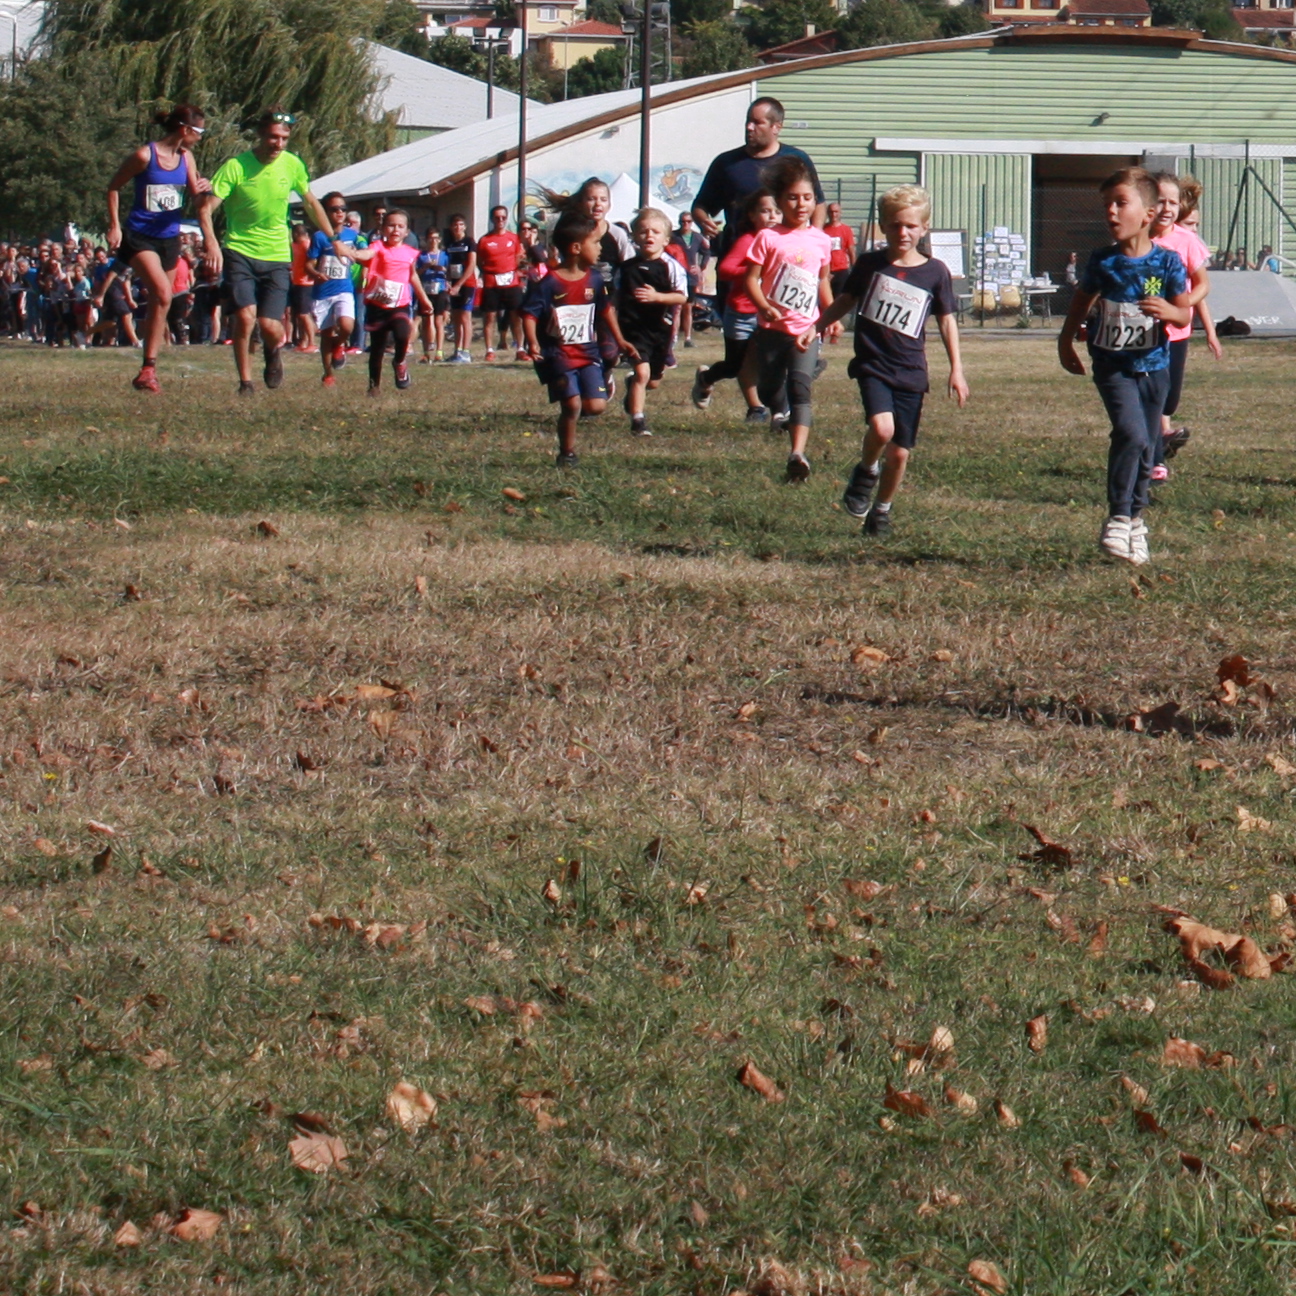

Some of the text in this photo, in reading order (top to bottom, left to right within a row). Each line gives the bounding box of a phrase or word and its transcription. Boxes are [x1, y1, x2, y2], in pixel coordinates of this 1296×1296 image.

[780, 284, 814, 314] 1234
[875, 299, 912, 331] 1174
[1106, 325, 1147, 348] 1223
